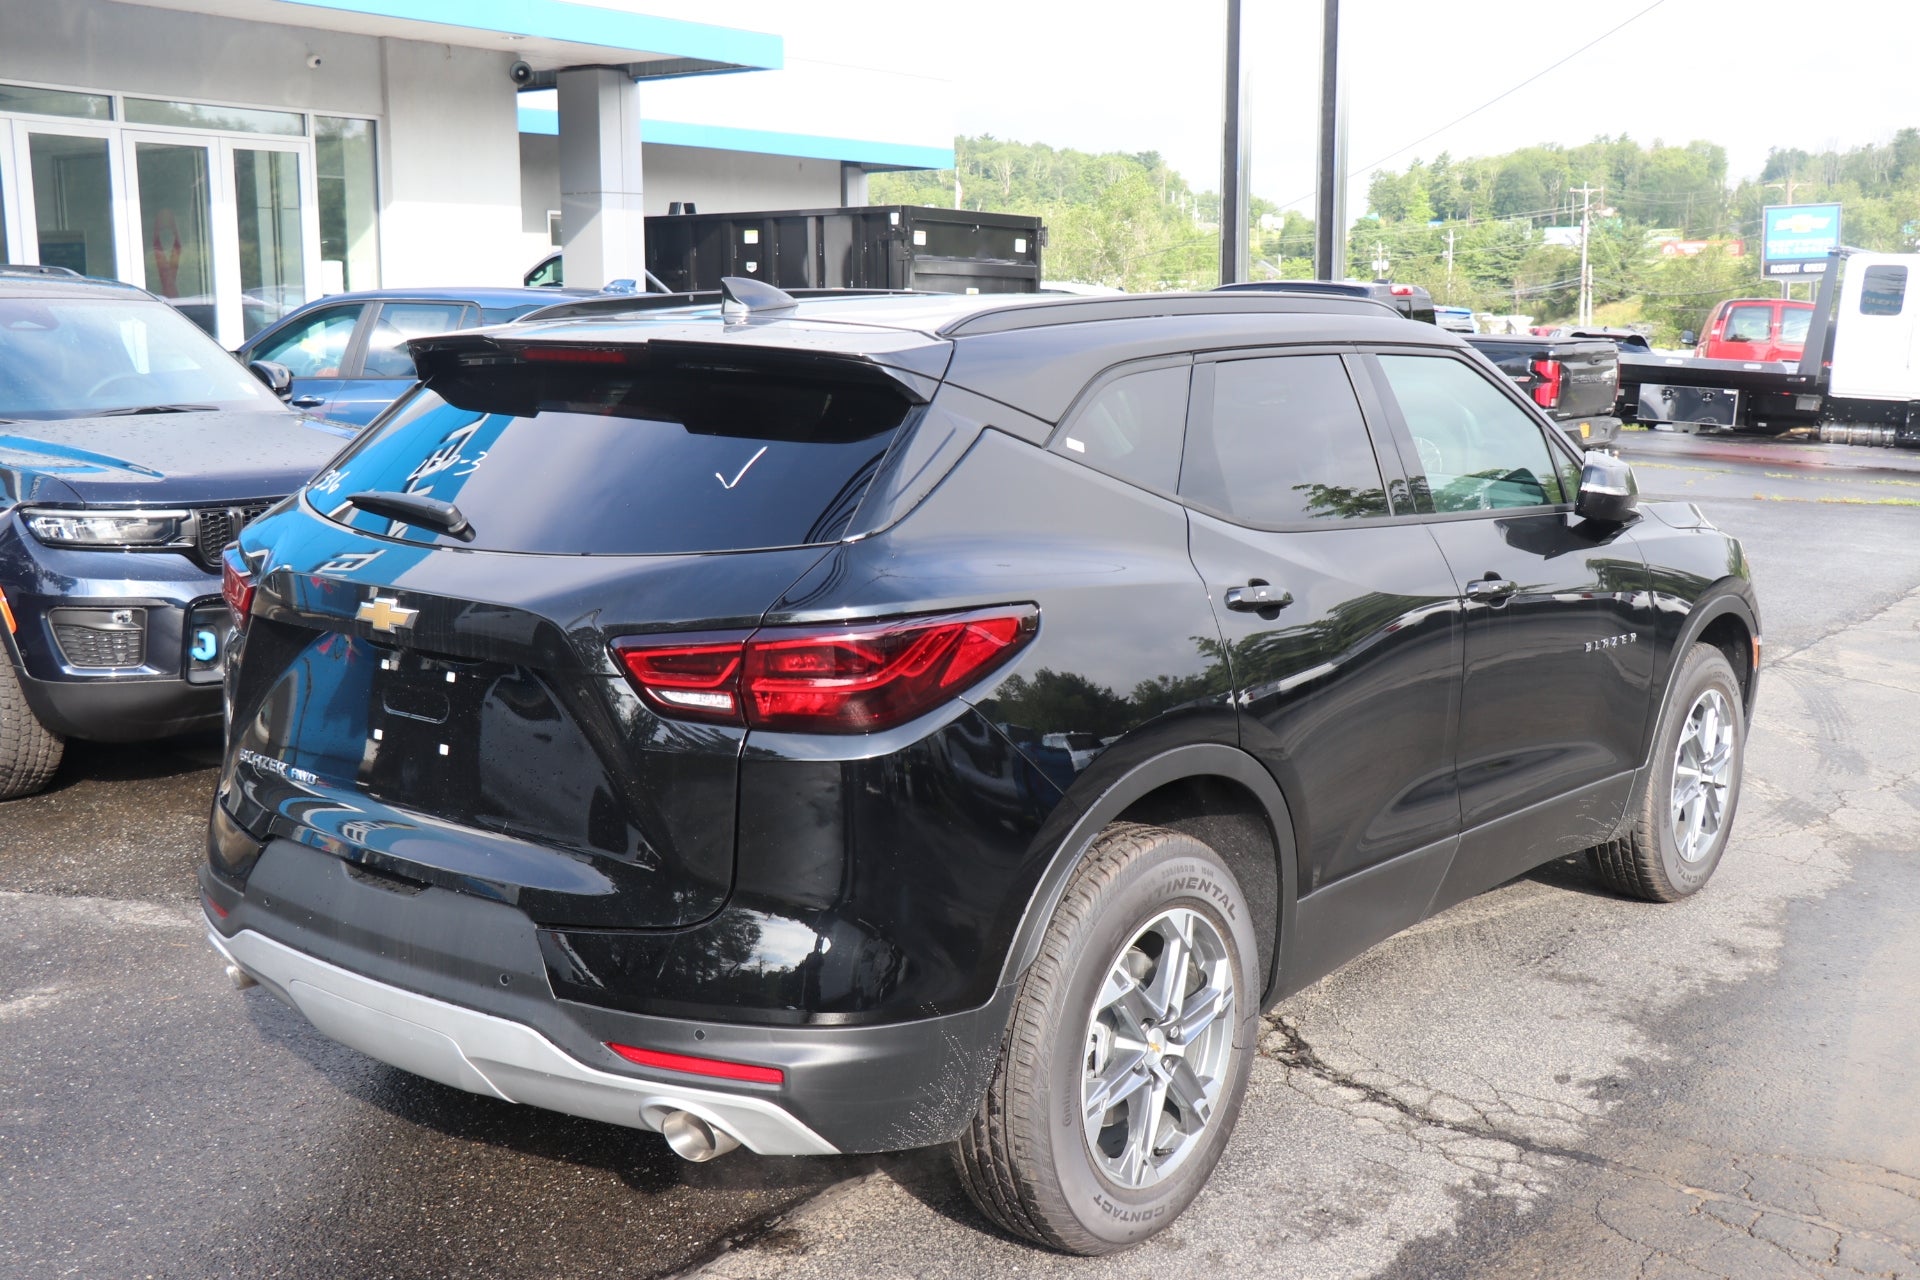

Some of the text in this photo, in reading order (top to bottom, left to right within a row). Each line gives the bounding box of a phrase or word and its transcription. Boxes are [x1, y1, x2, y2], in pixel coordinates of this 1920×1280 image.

[1770, 263, 1801, 274] ROBERT
[1584, 632, 1637, 653] BLAZER
[240, 748, 319, 785] BLAZER AWD
[1093, 1194, 1166, 1223] CONTACT
